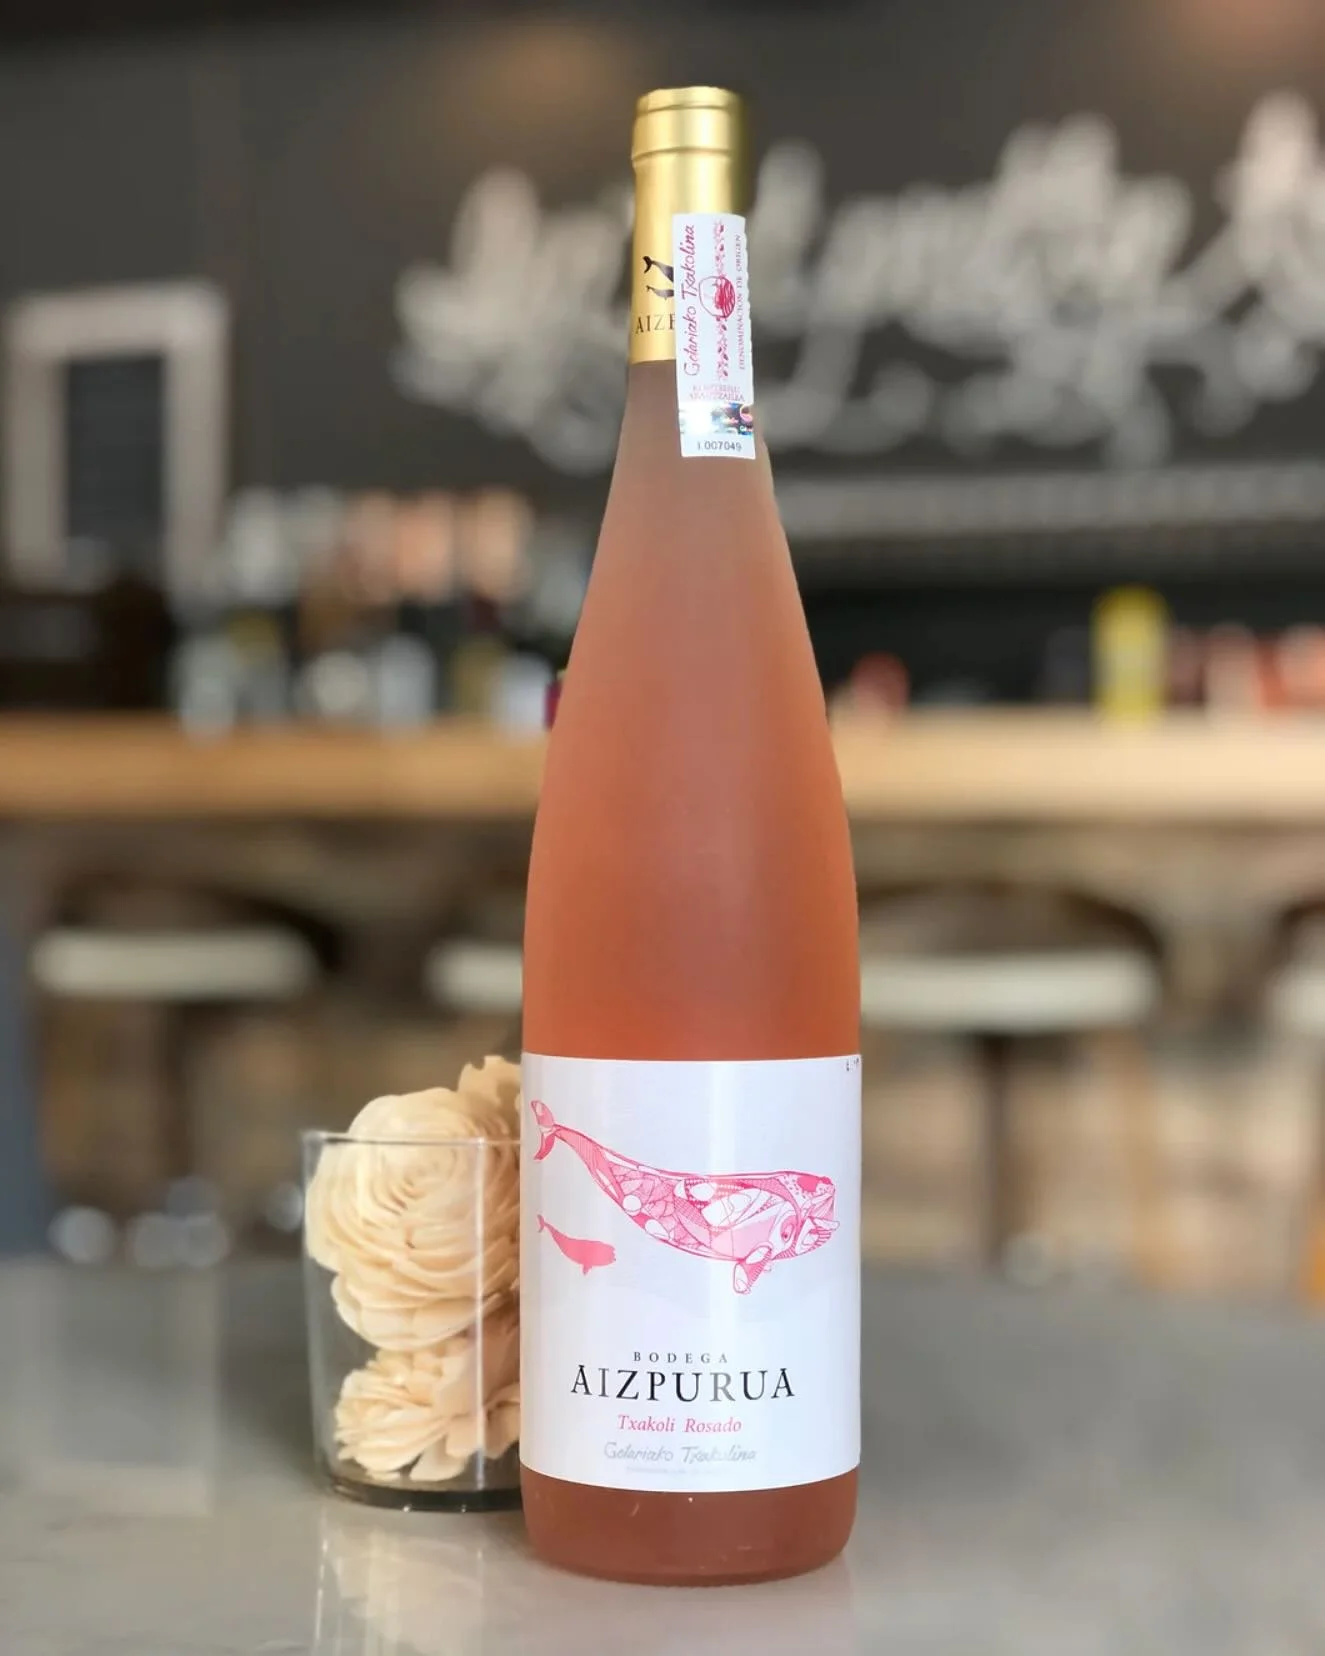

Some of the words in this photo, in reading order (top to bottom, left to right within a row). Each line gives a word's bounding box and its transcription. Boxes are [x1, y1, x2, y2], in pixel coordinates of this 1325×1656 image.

[679, 224, 698, 300] Txakolina
[633, 1351, 729, 1364] BODEGA
[570, 1364, 796, 1402] AIZPURUA
[617, 1414, 676, 1433] Txakoli
[683, 1415, 742, 1433] Rosado
